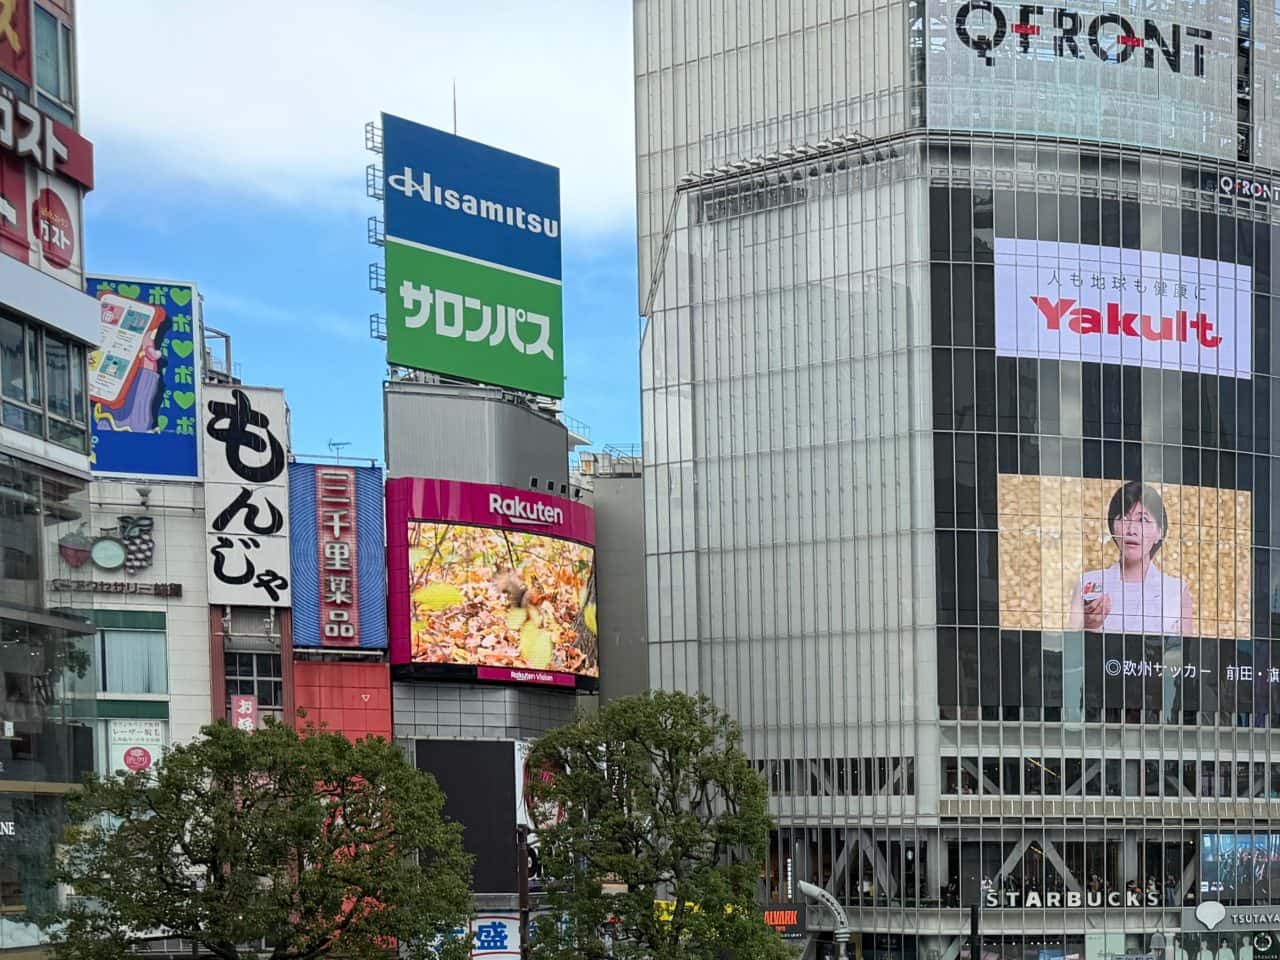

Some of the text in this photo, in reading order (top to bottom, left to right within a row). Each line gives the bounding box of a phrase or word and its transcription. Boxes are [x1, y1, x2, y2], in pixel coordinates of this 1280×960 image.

[955, 0, 1213, 77] QFRONT
[388, 166, 559, 239] Hisamitsu
[40, 218, 71, 250] ガスト
[1047, 269, 1208, 303] 人も地球も健康に
[400, 279, 555, 361] サロンパス
[1030, 295, 1223, 349] Yakult
[206, 388, 289, 602] もんじゃ
[488, 492, 564, 525] Rakuten
[319, 469, 356, 638] 三千里薬品
[510, 670, 535, 682] Rakuten
[985, 889, 1160, 908] STARBUCKS
[764, 910, 798, 926] ALVARK
[1231, 914, 1280, 925] TSUTAYA
